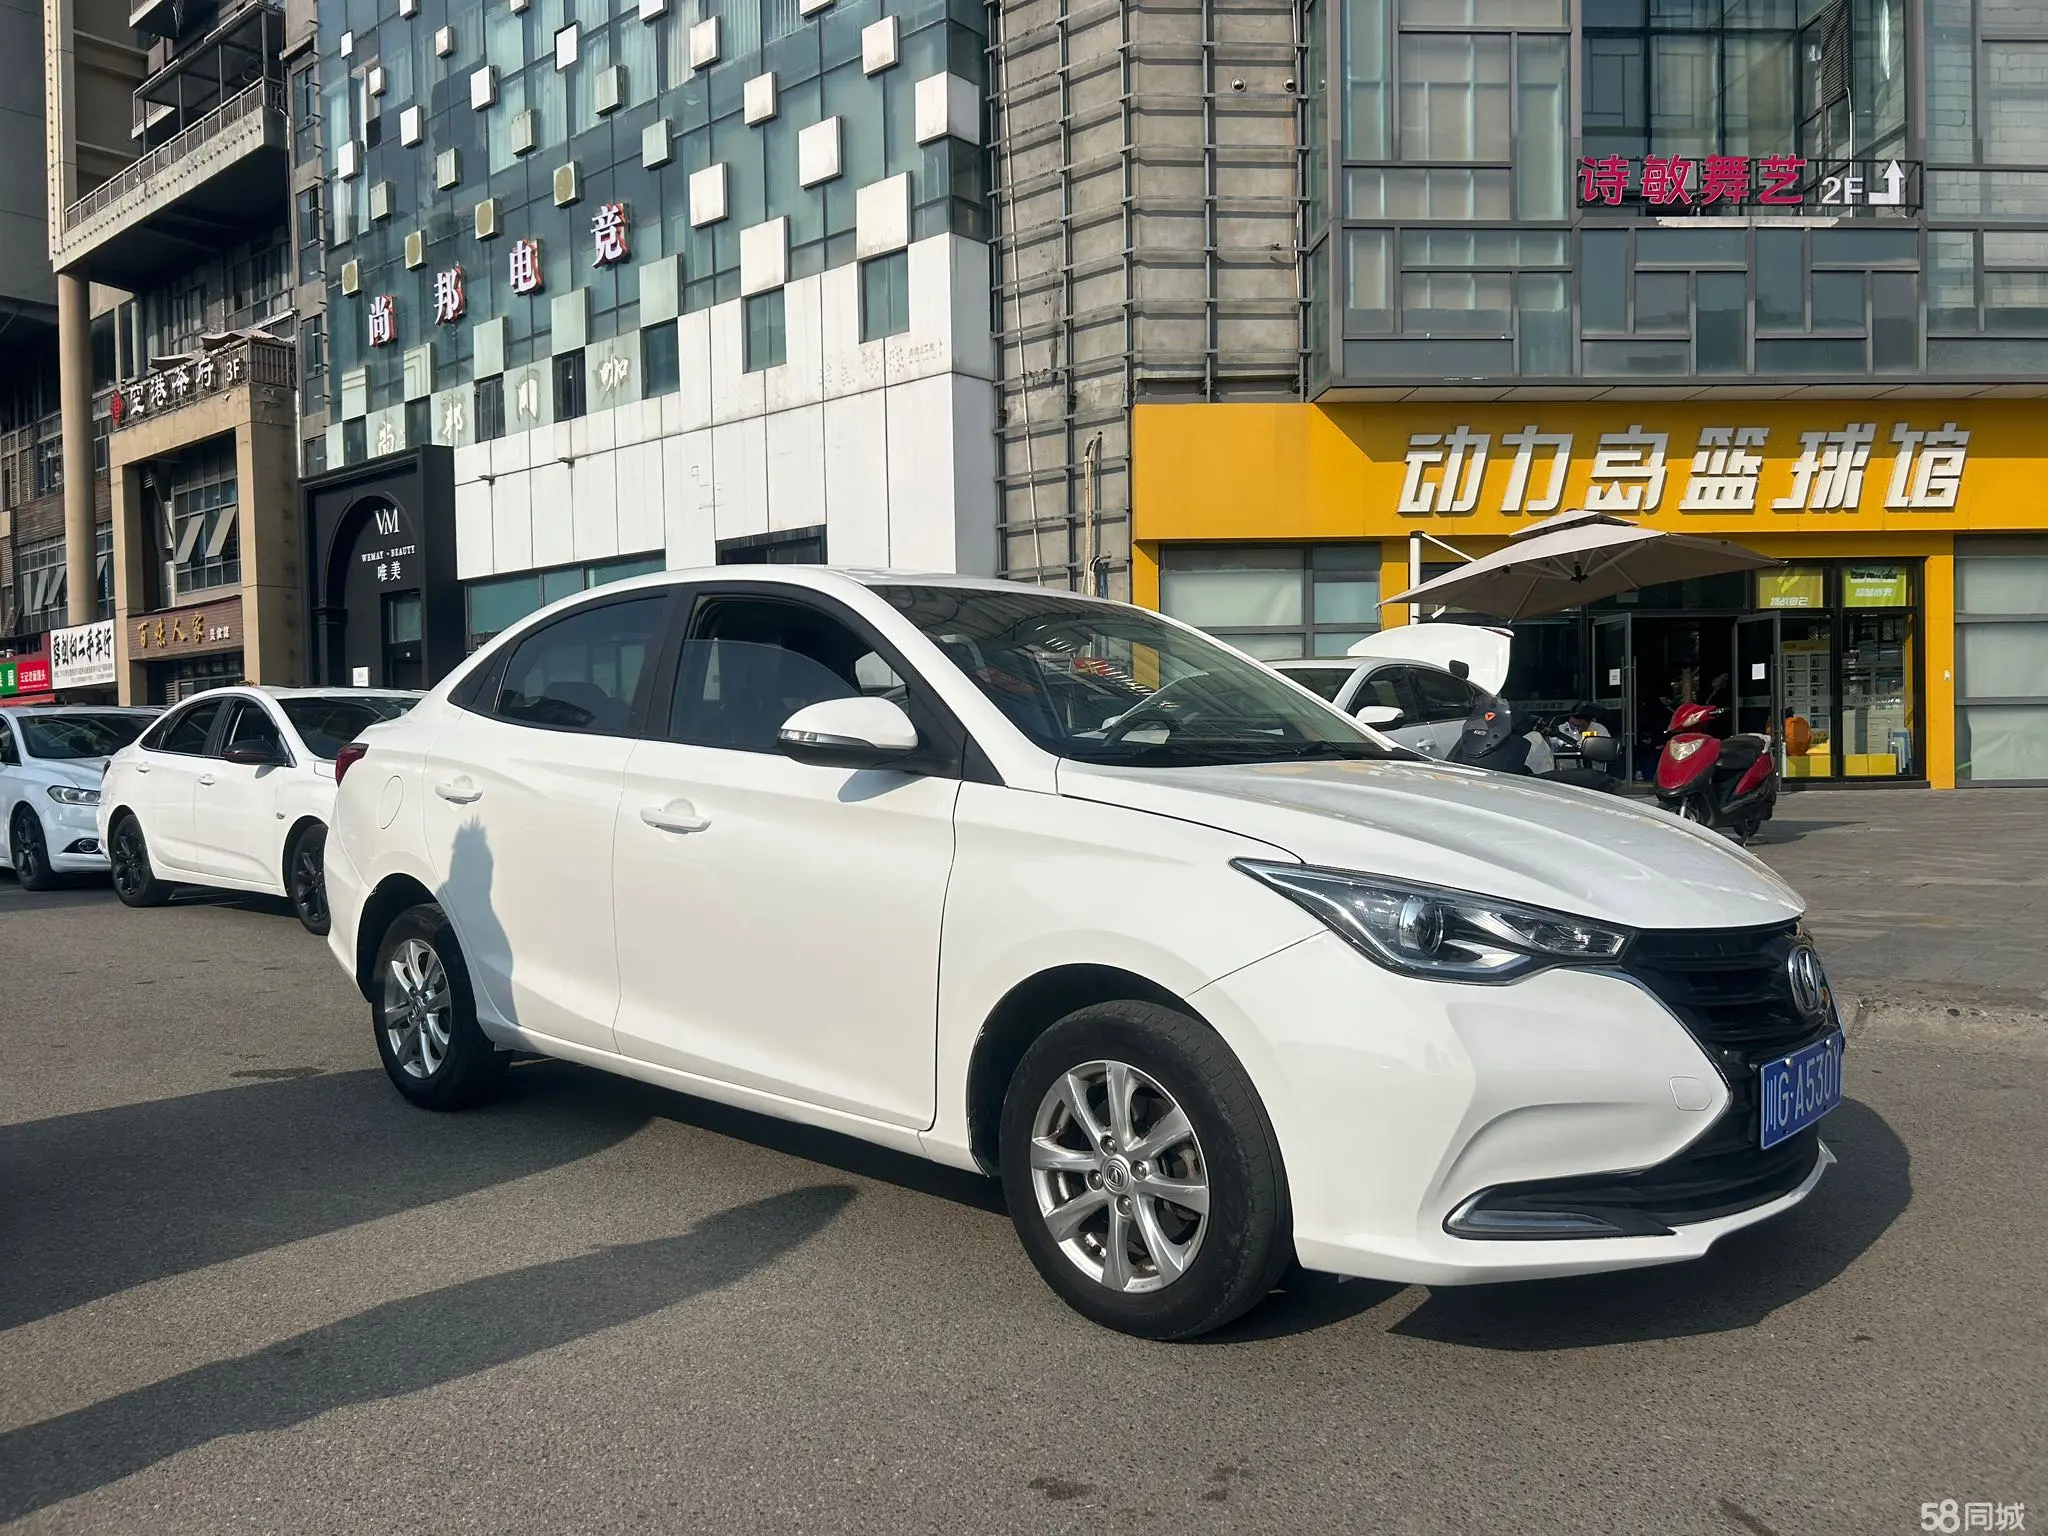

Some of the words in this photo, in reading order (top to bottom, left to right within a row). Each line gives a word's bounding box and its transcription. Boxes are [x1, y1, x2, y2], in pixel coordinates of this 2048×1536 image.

[1577, 153, 1807, 206] 诗敏舞艺
[1821, 176, 1864, 205] 2F
[368, 203, 630, 348] 尚邦电竞
[128, 355, 214, 415] 空港茶府
[226, 358, 240, 382] 3F
[1397, 422, 1971, 513] 动力岛篮球馆
[361, 550, 384, 563] WEMAY
[390, 545, 416, 558] BEAUTY
[377, 560, 402, 583] 唯美
